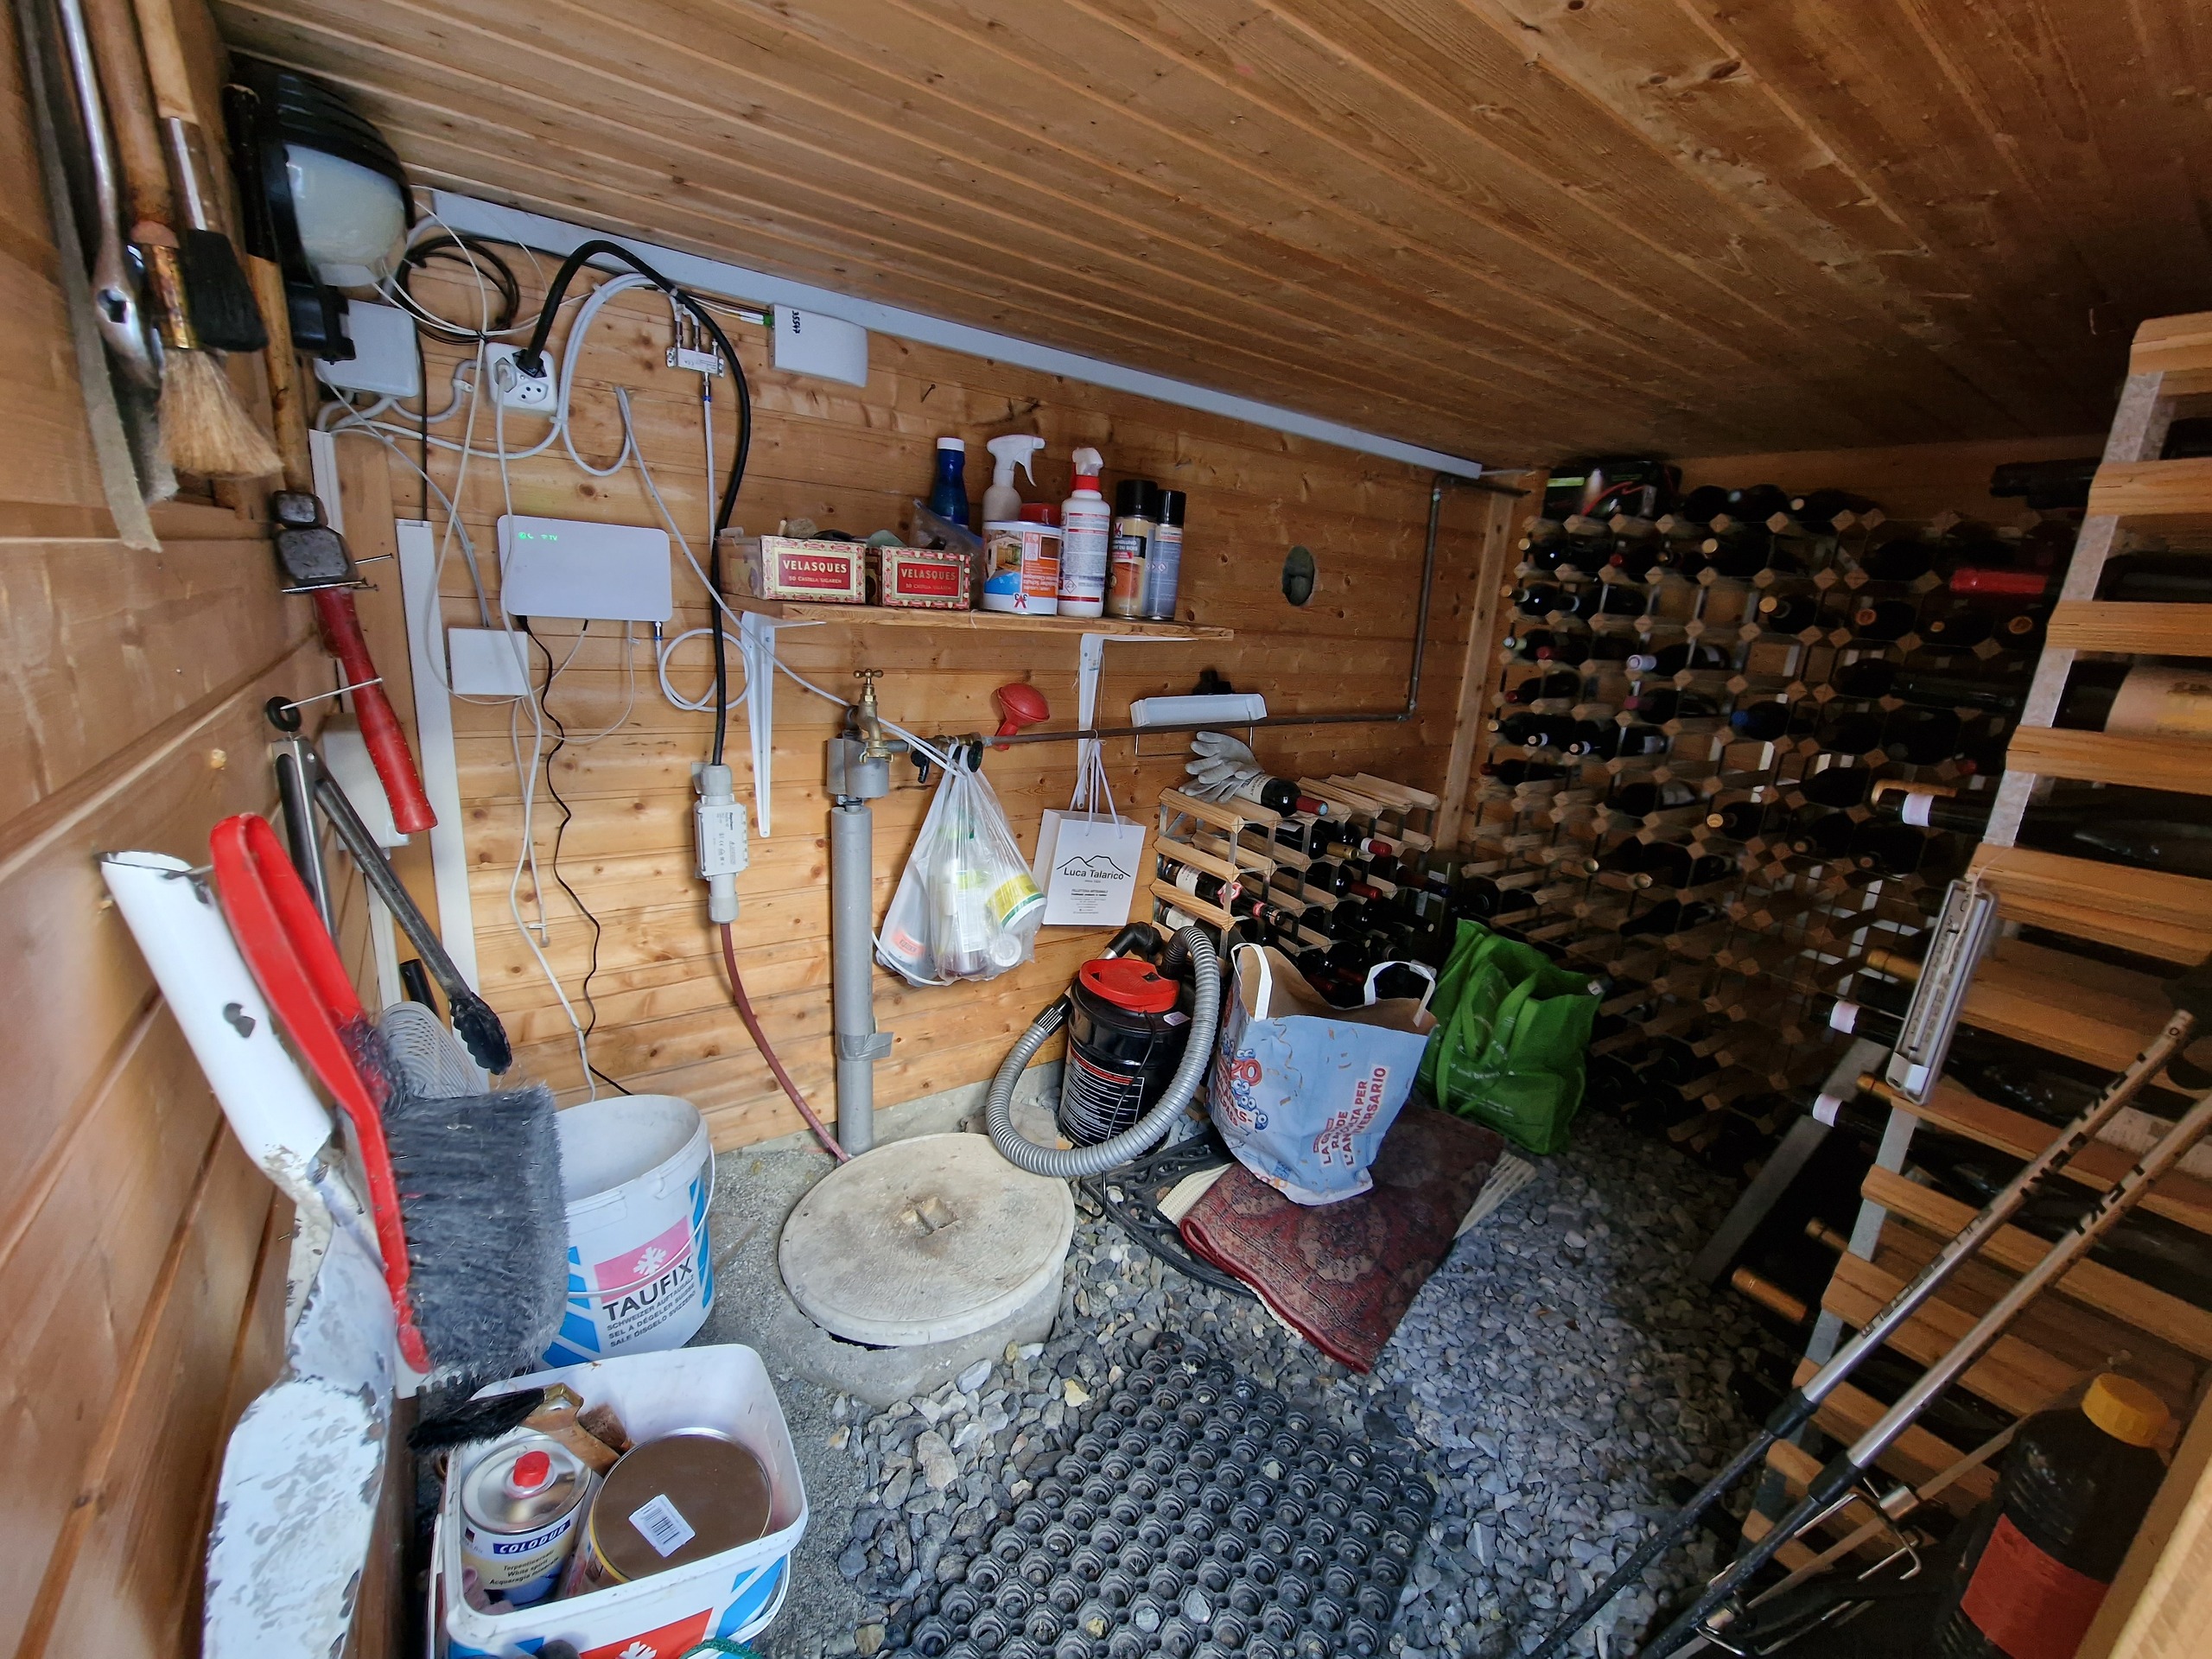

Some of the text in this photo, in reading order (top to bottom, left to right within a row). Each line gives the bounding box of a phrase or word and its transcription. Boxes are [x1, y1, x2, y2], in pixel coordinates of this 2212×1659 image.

[791, 309, 801, 334] 35547
[783, 559, 848, 575] VELASQUES
[900, 567, 957, 582] VELASQUES
[1064, 868, 1124, 880] Luca Talarico
[1355, 1080, 1368, 1105] PER
[1320, 1146, 1332, 1165] LA
[602, 1254, 693, 1321] TAUFIX
[607, 1306, 655, 1331] SCHWEIZER
[608, 1328, 626, 1339] SEL
[637, 1301, 673, 1326] DÉGELER
[674, 1282, 695, 1304] SUISSE
[610, 1290, 696, 1348] SALE DISGELO SVIZZERO
[499, 1523, 567, 1554] COLODUR
[507, 1559, 548, 1578] White spirit
